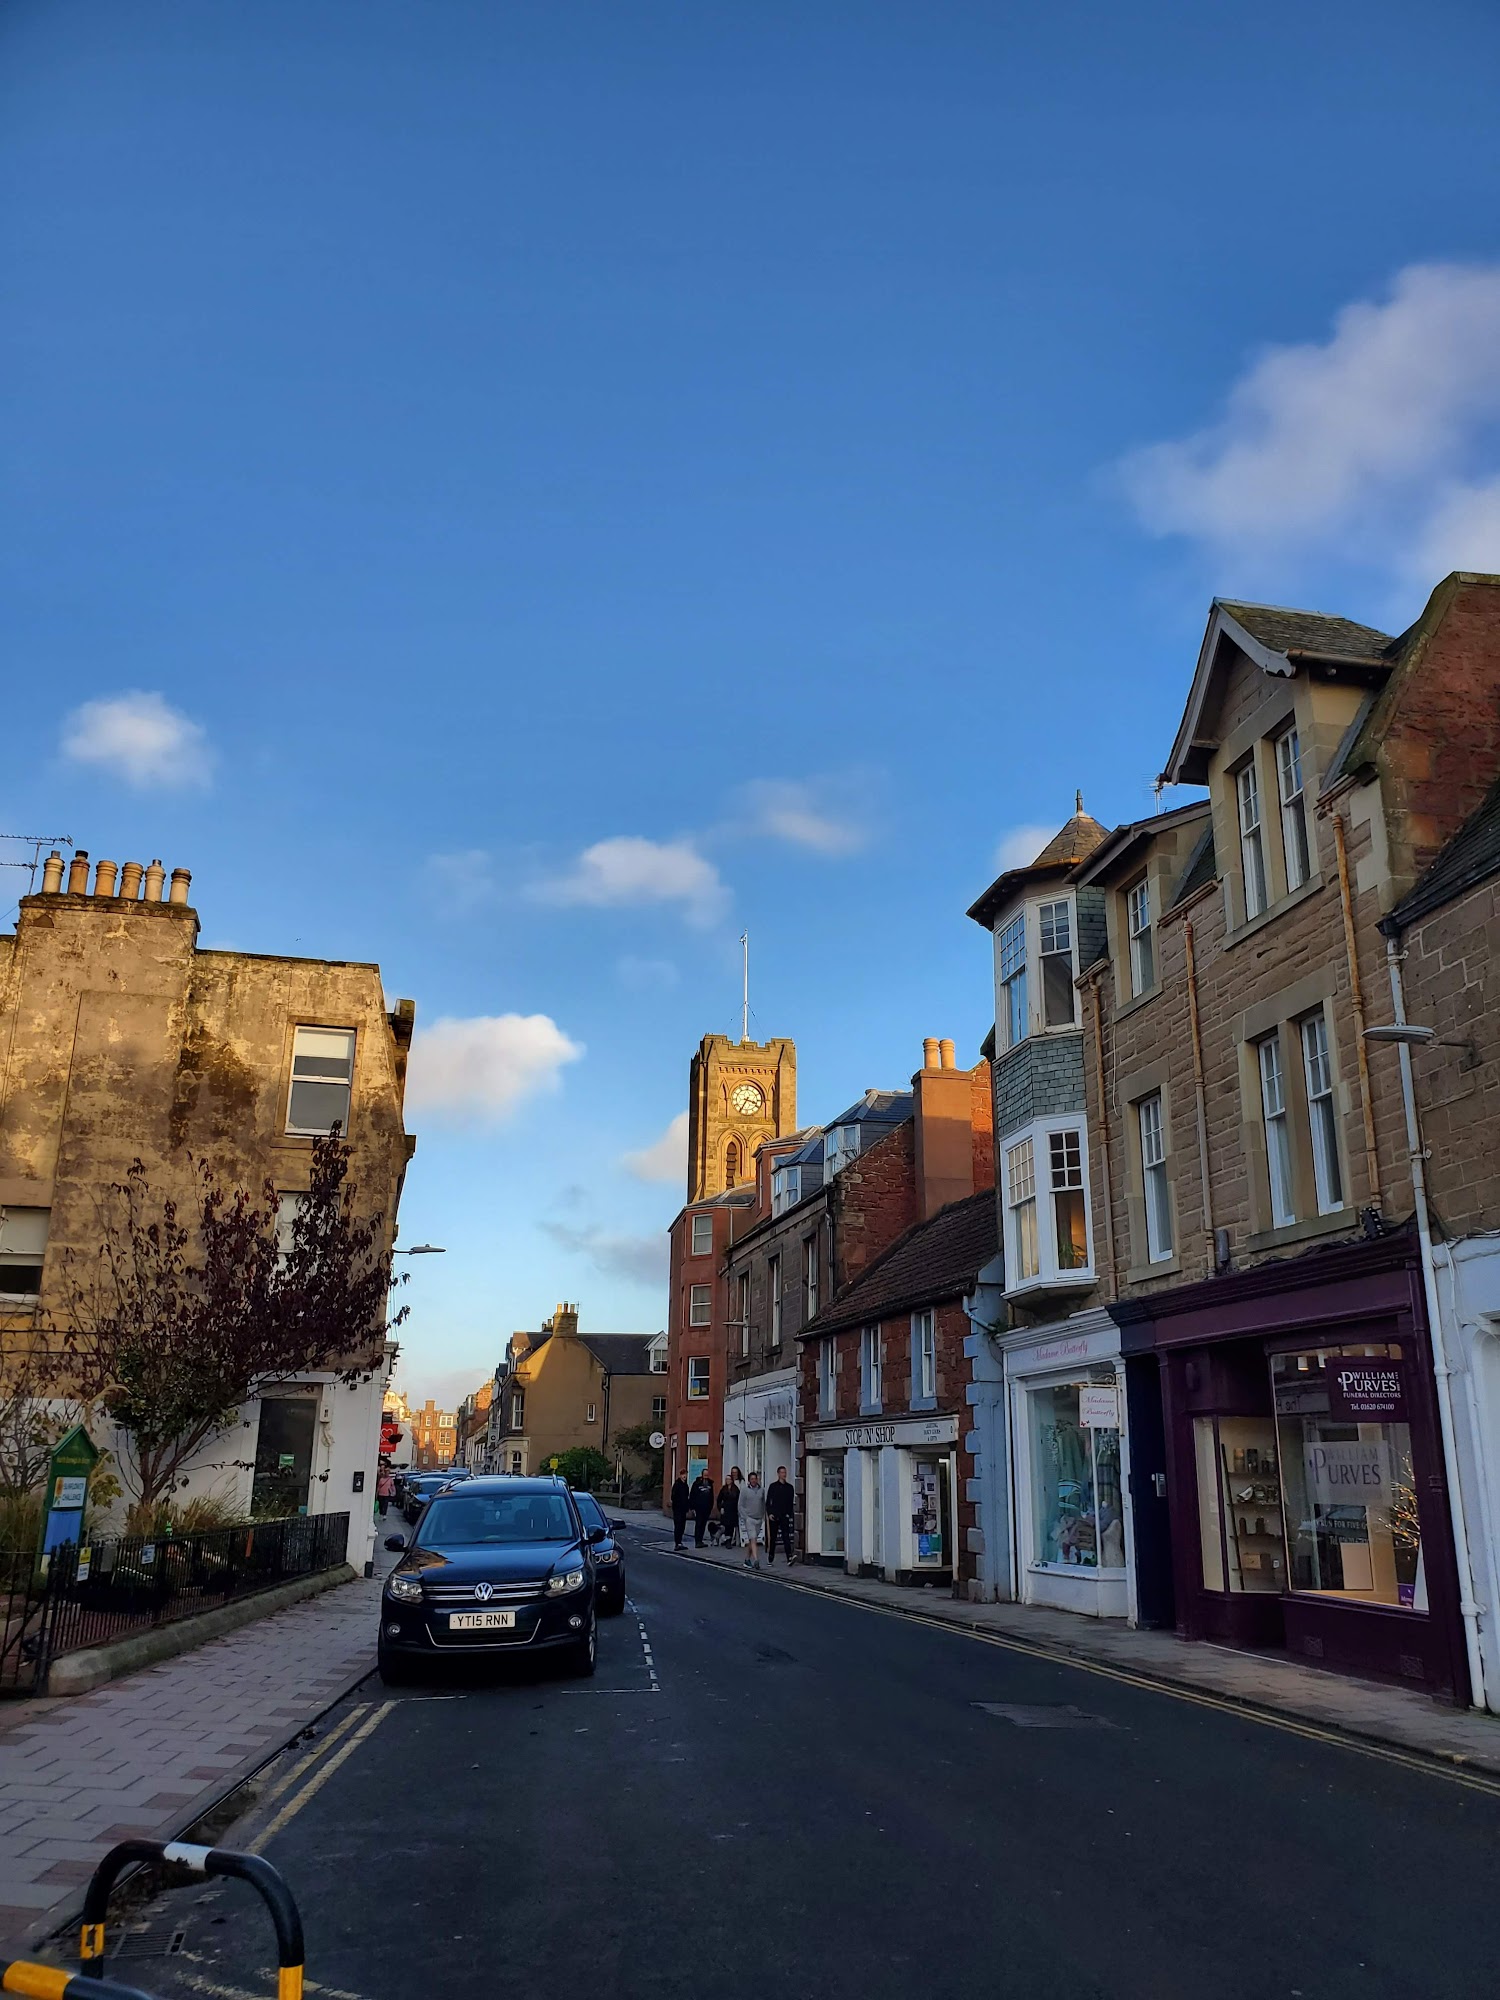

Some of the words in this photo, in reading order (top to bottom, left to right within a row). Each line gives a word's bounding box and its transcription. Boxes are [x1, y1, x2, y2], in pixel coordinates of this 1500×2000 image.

[1034, 1346, 1058, 1360] Madame
[1061, 1340, 1088, 1358] Butterfly
[1340, 1371, 1397, 1392] PURVES
[1351, 1371, 1395, 1380] WILLIAM
[1083, 1396, 1115, 1404] Madame
[1083, 1408, 1116, 1418] Butterfly
[845, 1429, 862, 1446] STOP
[875, 1426, 896, 1443] SHOP
[1326, 1447, 1378, 1462] WILLIAM
[1312, 1447, 1381, 1485] PURVES
[1334, 1520, 1345, 1528] FOR
[1347, 1521, 1360, 1529] FIVE
[457, 1615, 482, 1627] YT15
[486, 1614, 508, 1626] RNN
